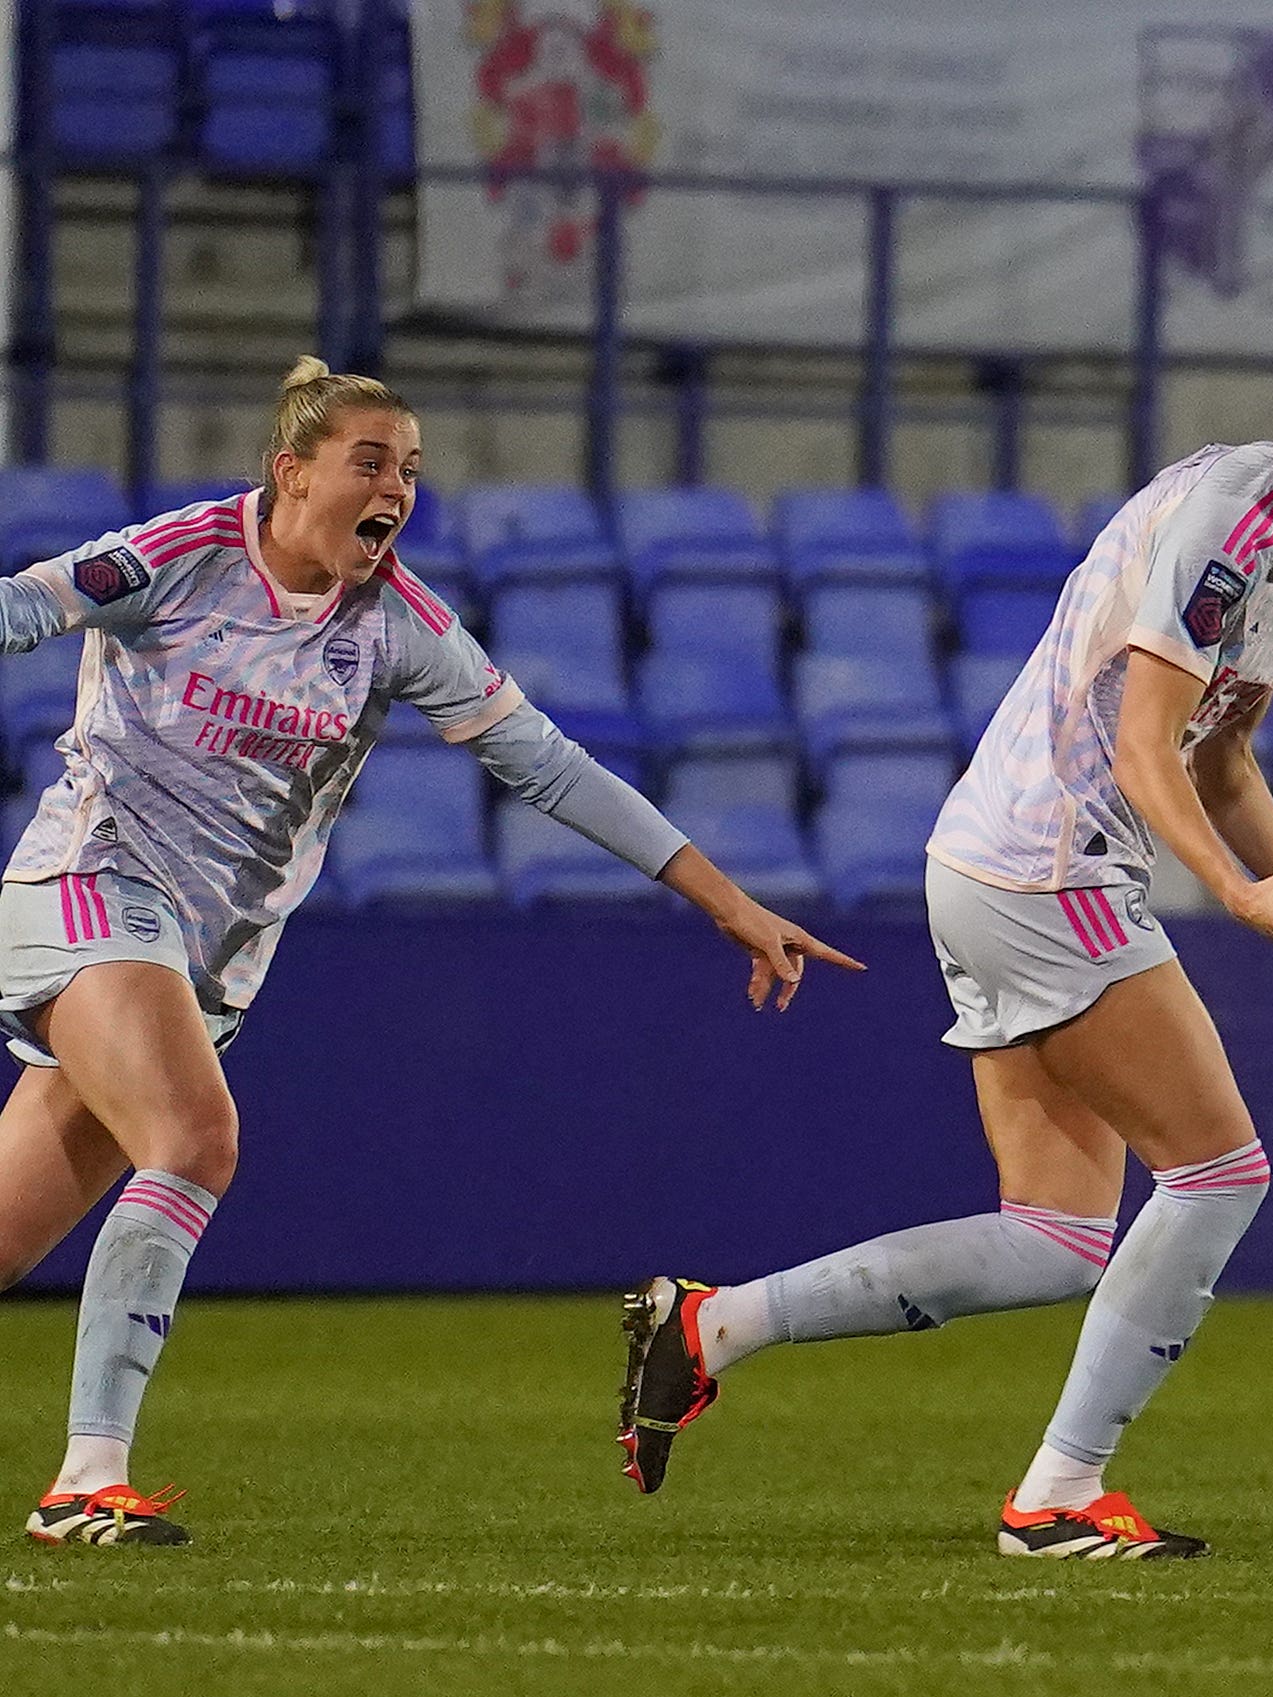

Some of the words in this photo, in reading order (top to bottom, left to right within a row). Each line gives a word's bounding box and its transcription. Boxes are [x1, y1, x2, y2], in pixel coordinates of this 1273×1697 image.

[182, 671, 349, 742] Emirates
[194, 720, 239, 755] FLY
[239, 729, 316, 770] BETTER
